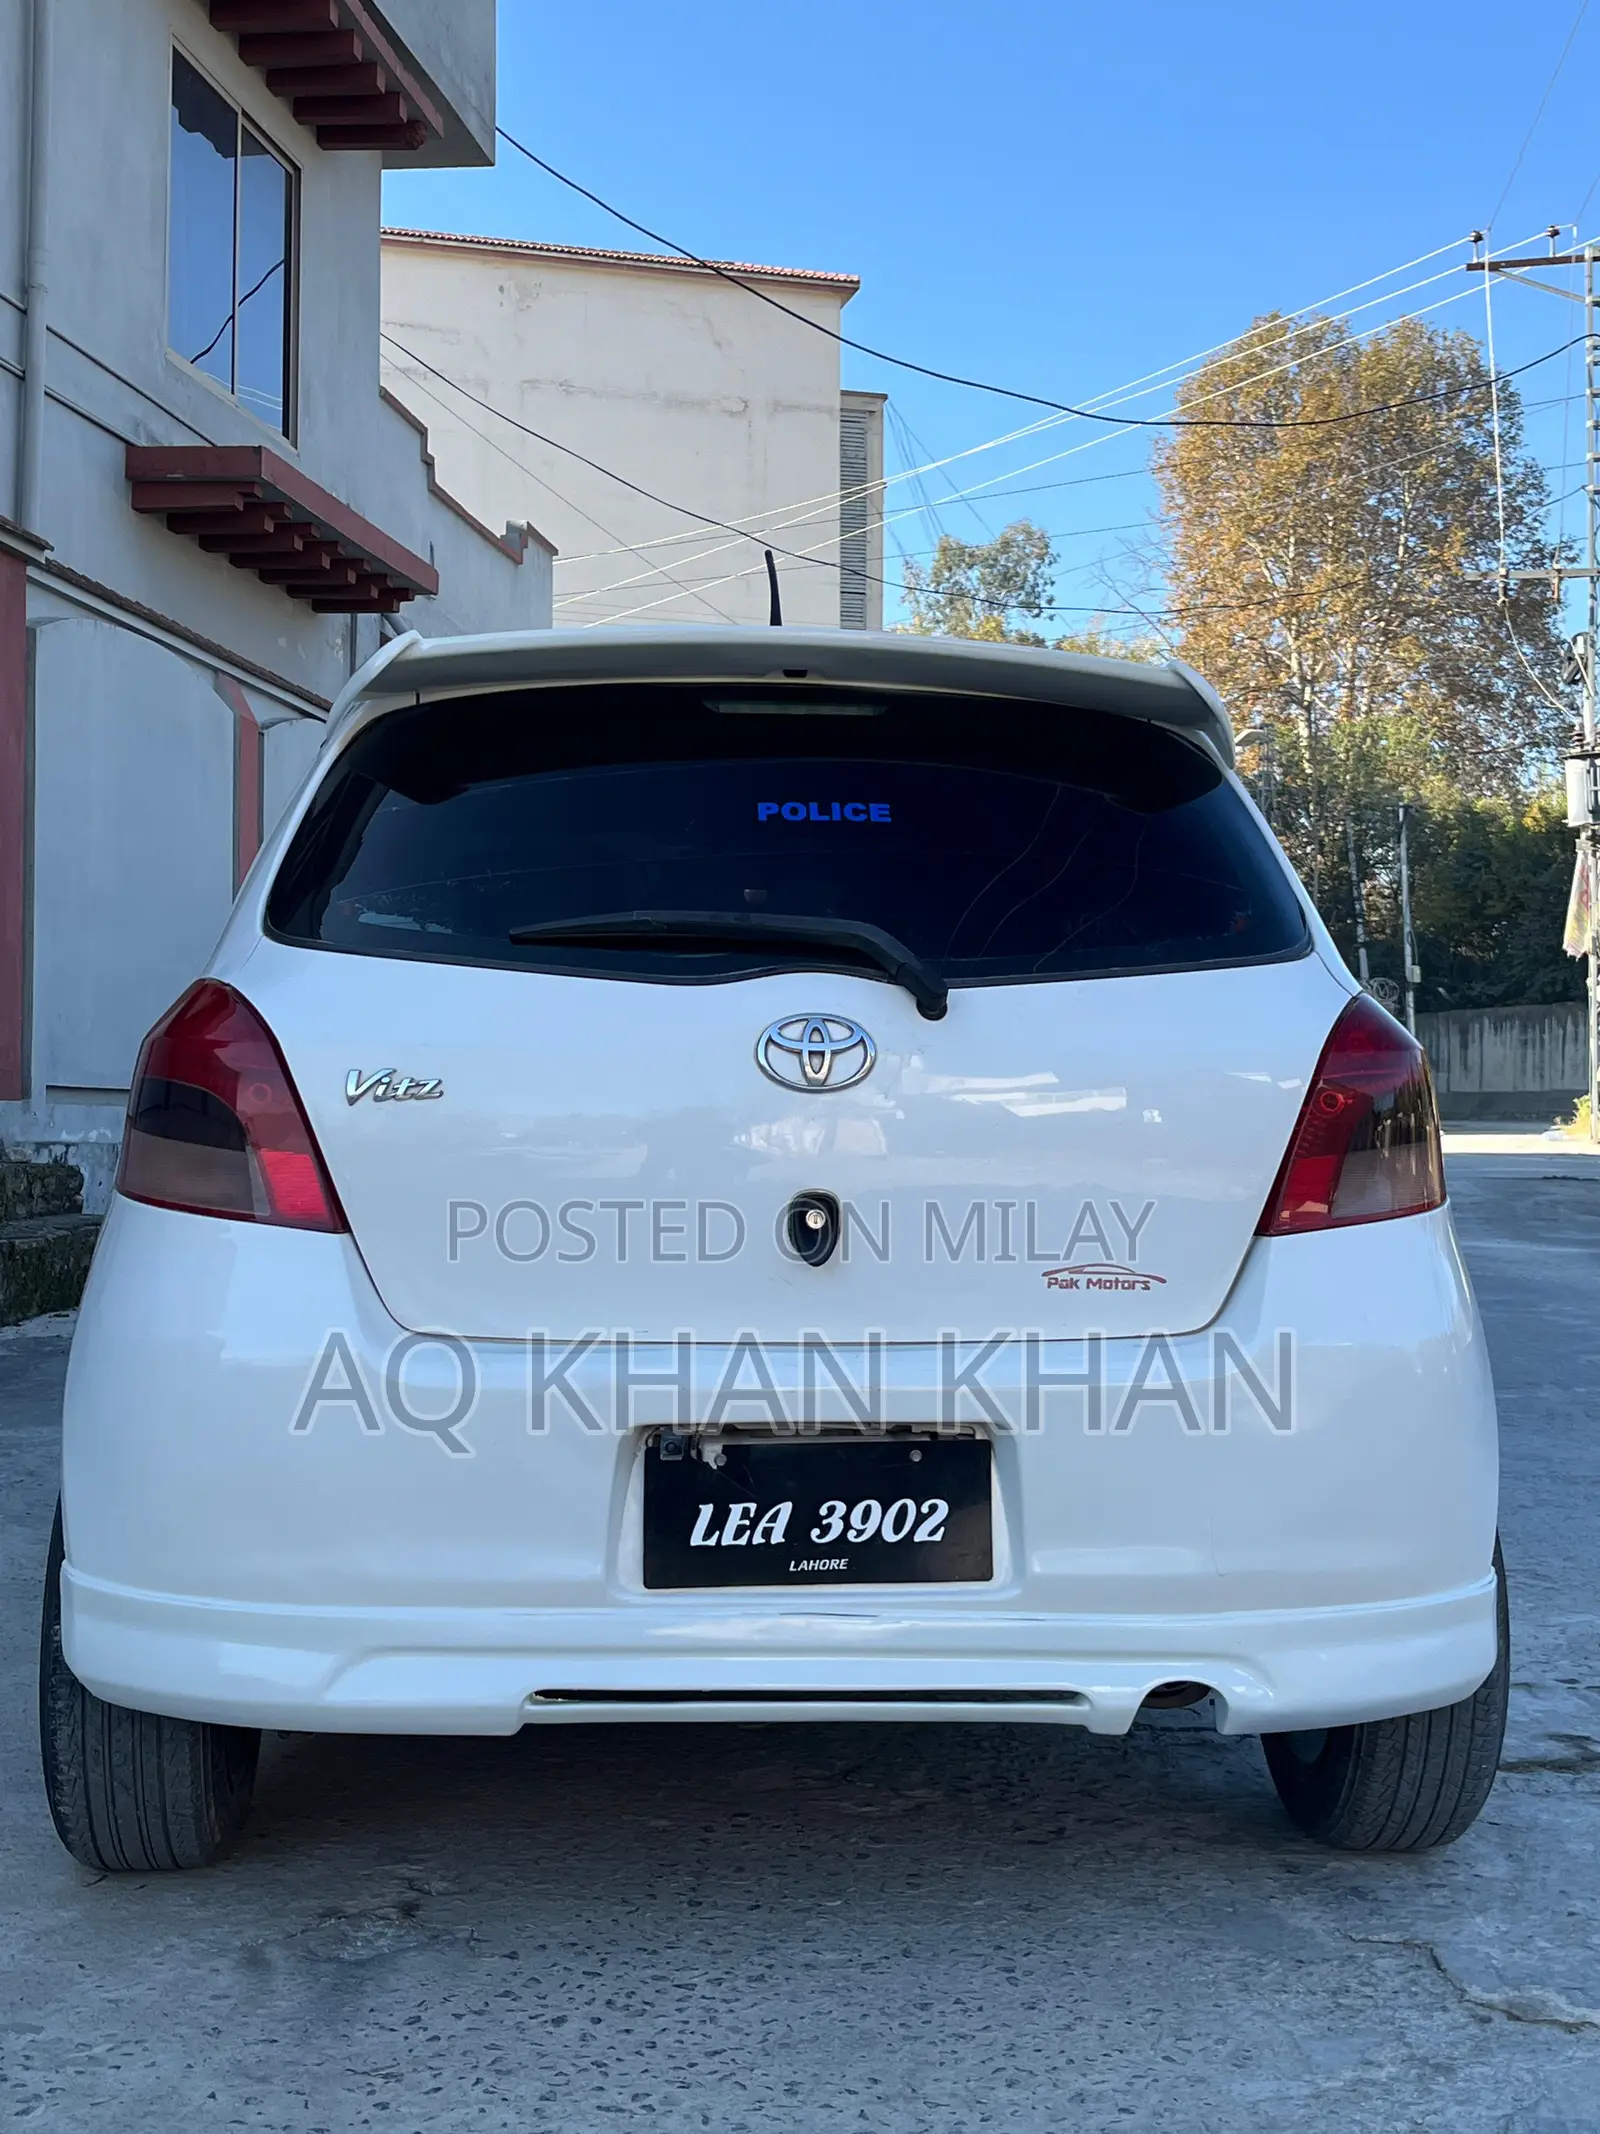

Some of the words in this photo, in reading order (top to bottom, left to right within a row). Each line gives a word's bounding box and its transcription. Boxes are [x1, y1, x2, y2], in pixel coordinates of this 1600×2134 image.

[757, 802, 891, 822] POLICE
[346, 1067, 444, 1107] Vitz
[1046, 1276, 1080, 1290] Pak
[1086, 1276, 1151, 1291] Motors
[690, 1500, 793, 1547] LEA
[810, 1498, 949, 1545] 3902
[789, 1558, 849, 1573] LAHORE
